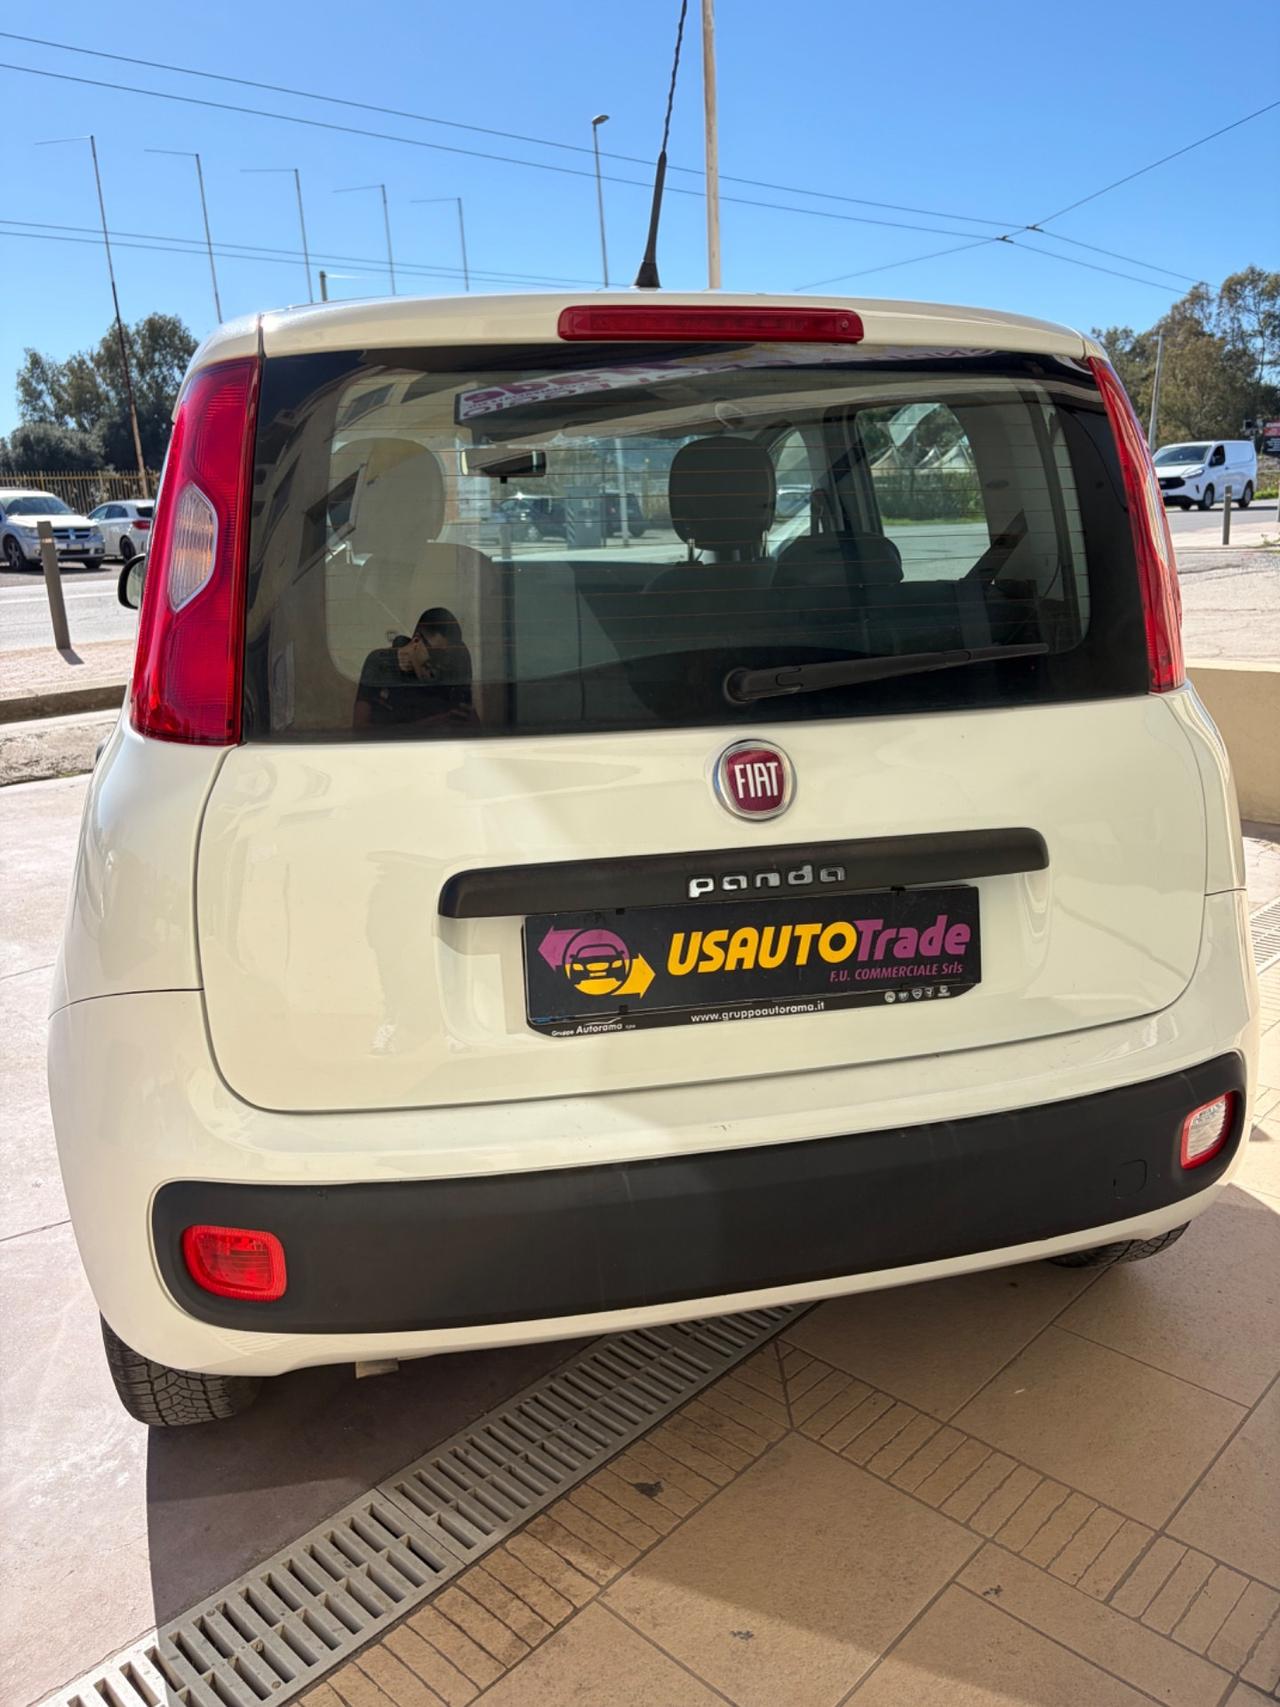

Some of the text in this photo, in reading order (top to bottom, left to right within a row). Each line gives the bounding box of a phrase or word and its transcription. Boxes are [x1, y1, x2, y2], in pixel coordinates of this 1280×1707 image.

[734, 762, 778, 798] FIAT
[688, 864, 845, 898] panda
[829, 961, 963, 982] F.U. COMMERCIALE Srls
[690, 1001, 825, 1022] www.gruppoautorama.it
[575, 1023, 623, 1034] Autorama
